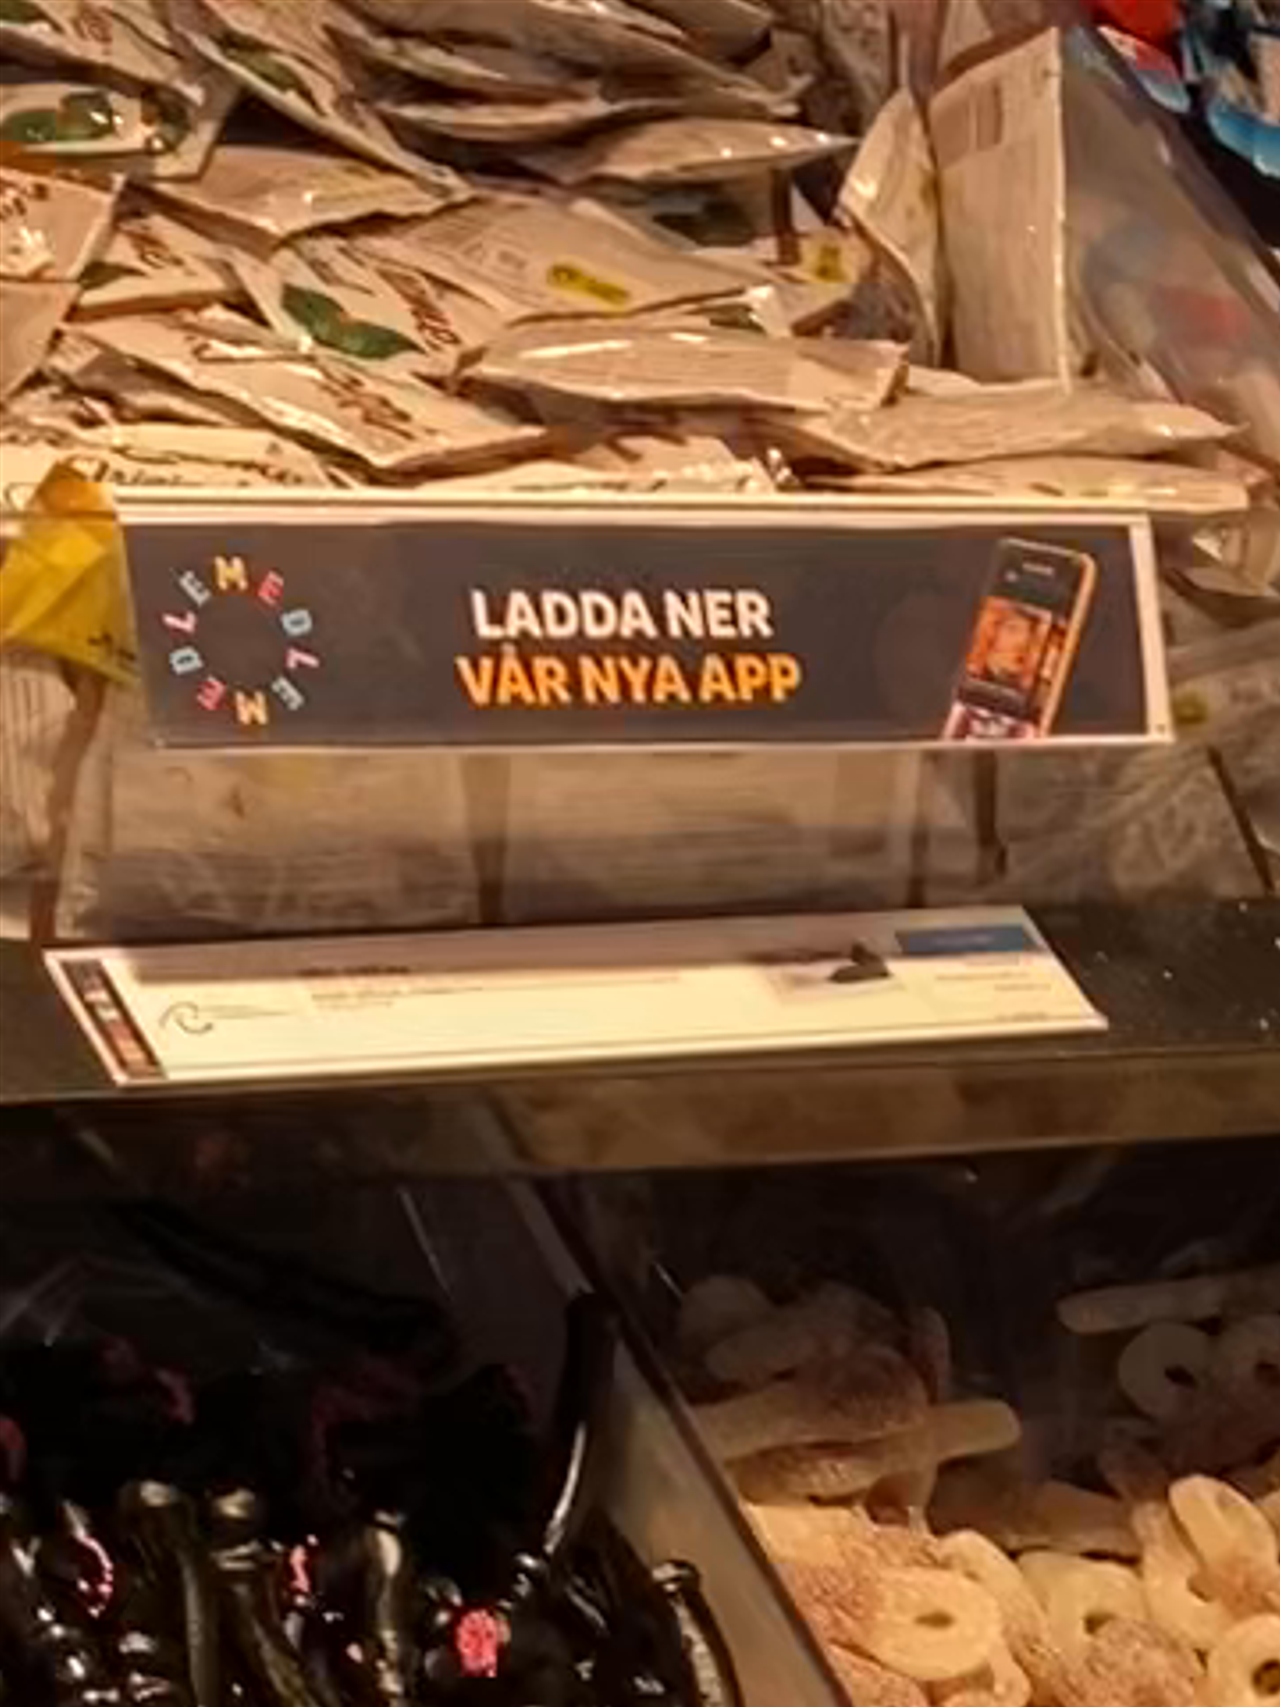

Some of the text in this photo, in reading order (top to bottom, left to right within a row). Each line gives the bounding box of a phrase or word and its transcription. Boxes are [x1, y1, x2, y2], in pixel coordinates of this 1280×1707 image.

[471, 588, 773, 640] LADDA NER
[456, 644, 803, 706] VÅR NYA APP
